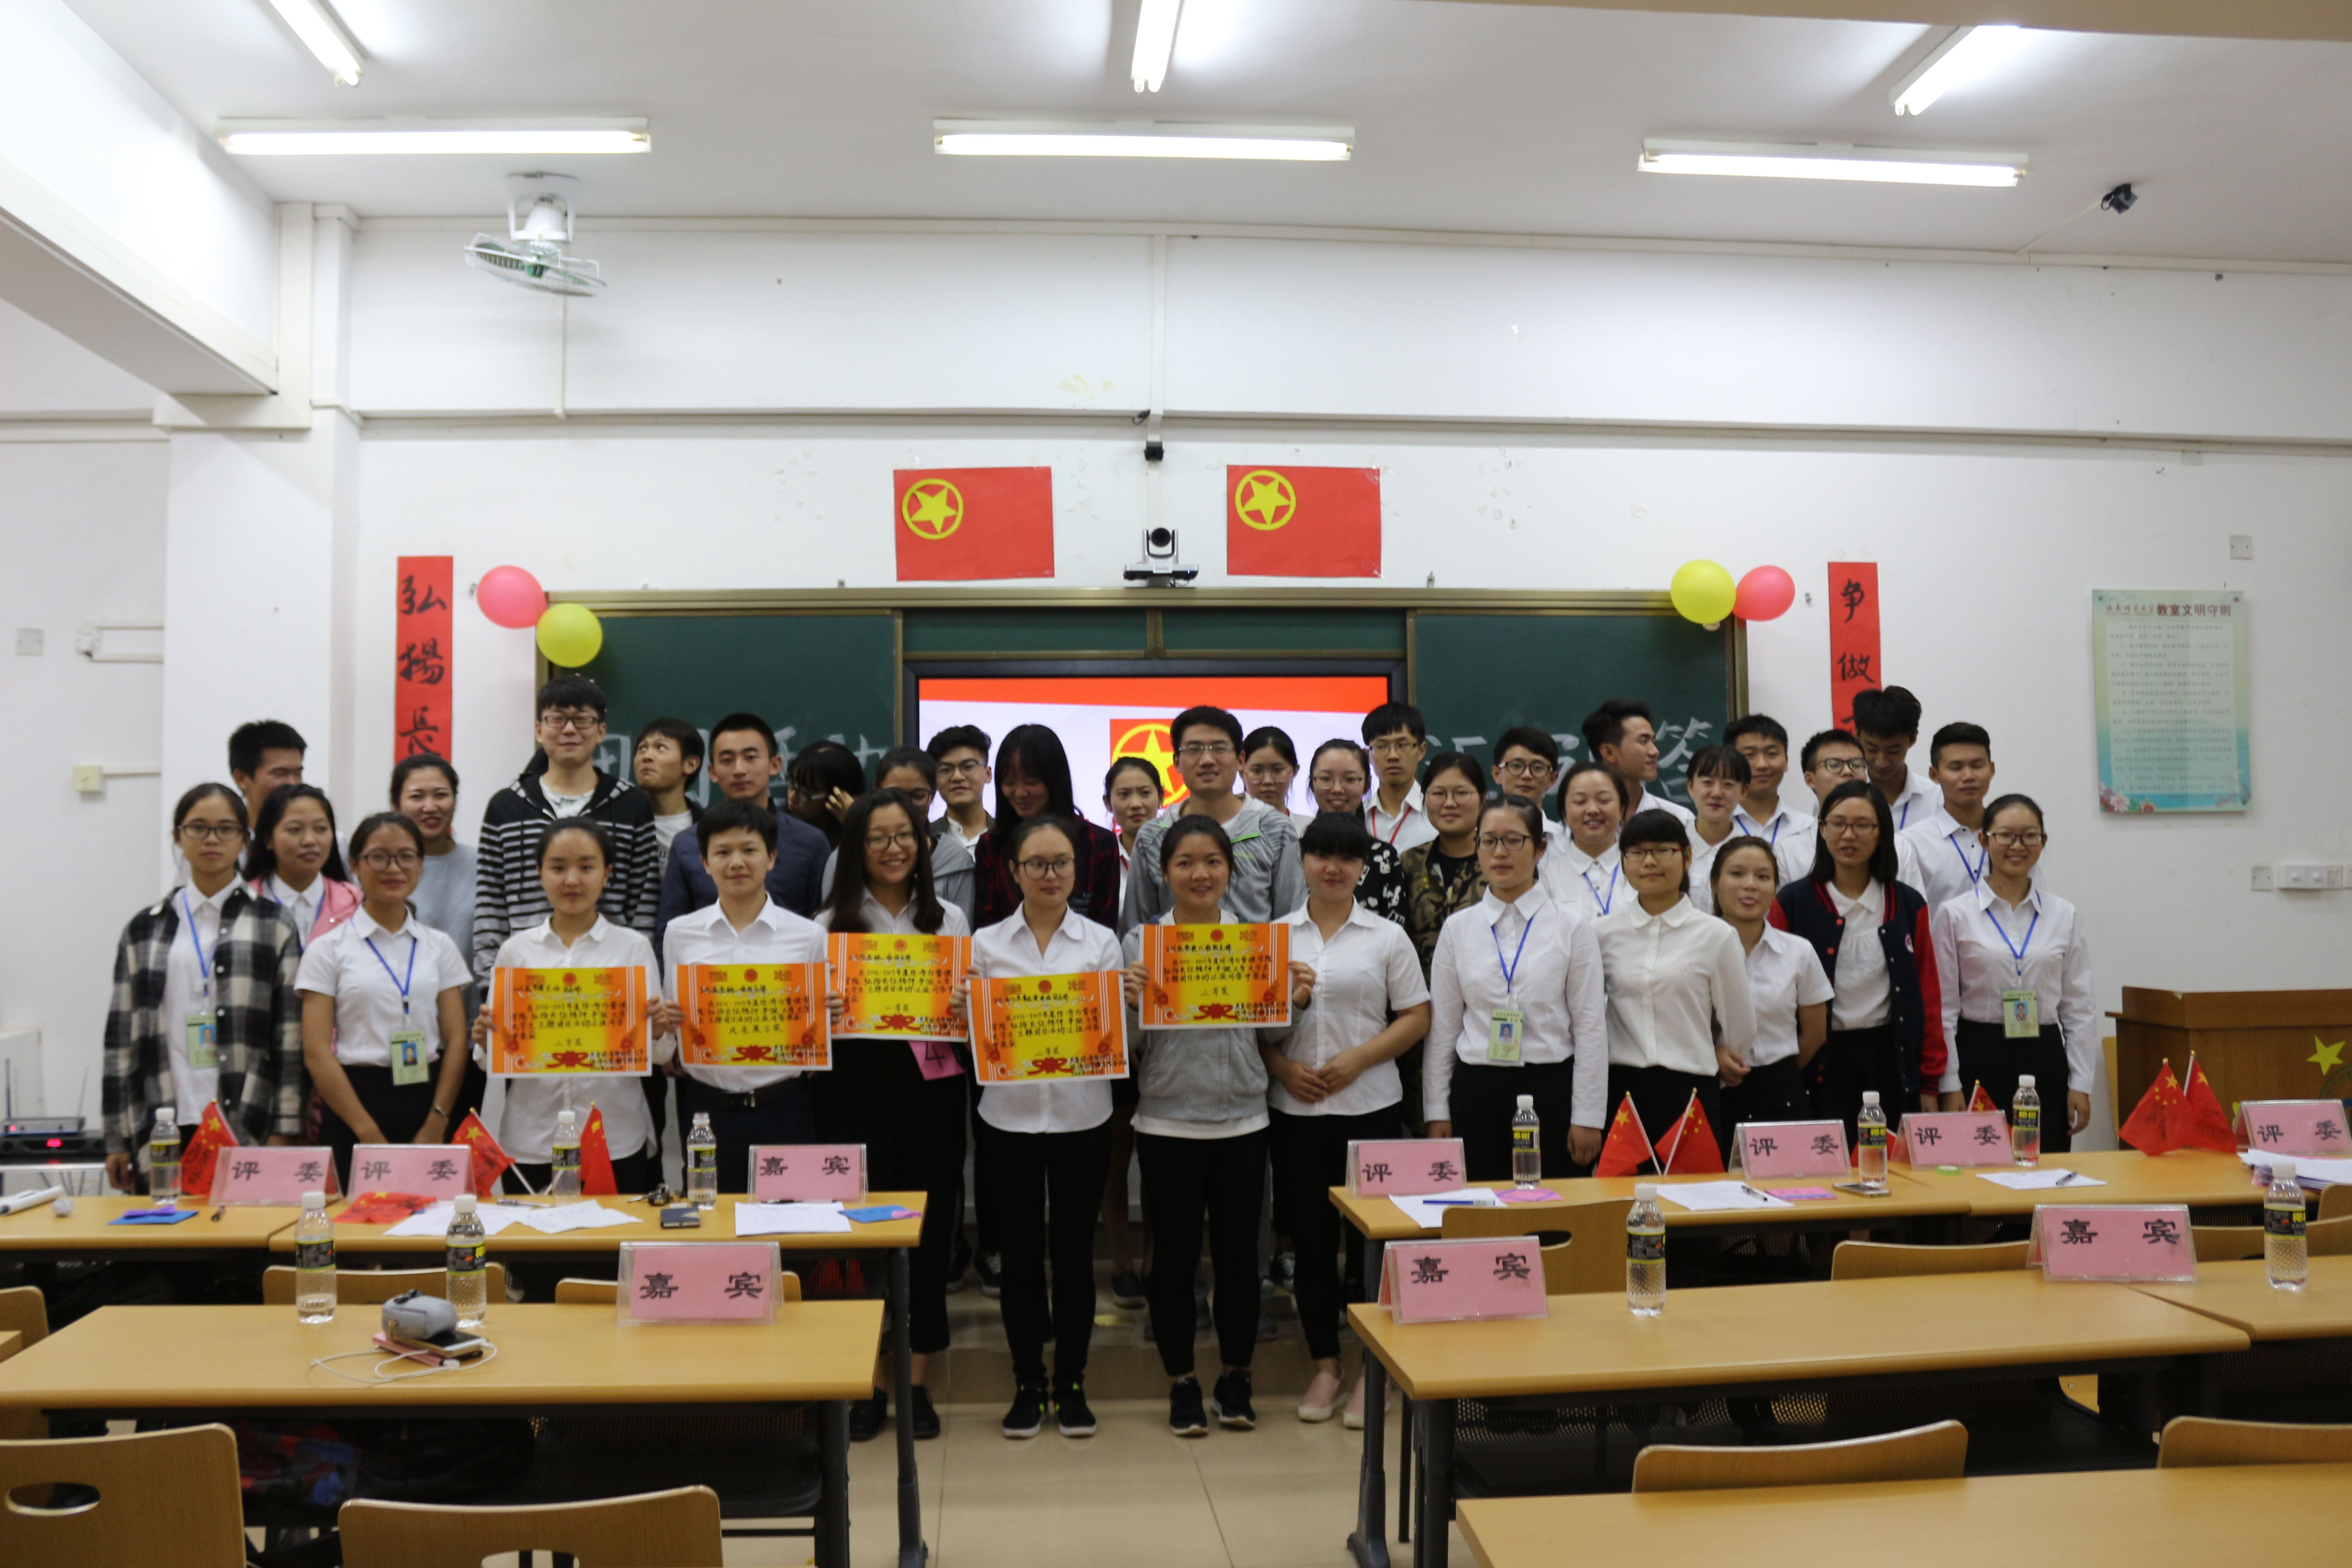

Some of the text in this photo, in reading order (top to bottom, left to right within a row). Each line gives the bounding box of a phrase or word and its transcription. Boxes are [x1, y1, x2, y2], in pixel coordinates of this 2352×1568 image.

[2157, 604, 2231, 617] 教室文明守则
[1915, 1125, 2001, 1147] 评委
[2257, 1119, 2342, 1144] 评委
[1749, 1134, 1839, 1157] 评委
[230, 1160, 324, 1184] 评委
[360, 1159, 458, 1182] 评委
[759, 1155, 851, 1177] 嘉宾
[1362, 1160, 1458, 1183] 评委
[2060, 1218, 2181, 1245] 嘉宾
[1410, 1252, 1531, 1284] 嘉宾
[639, 1271, 764, 1300] 嘉宾
